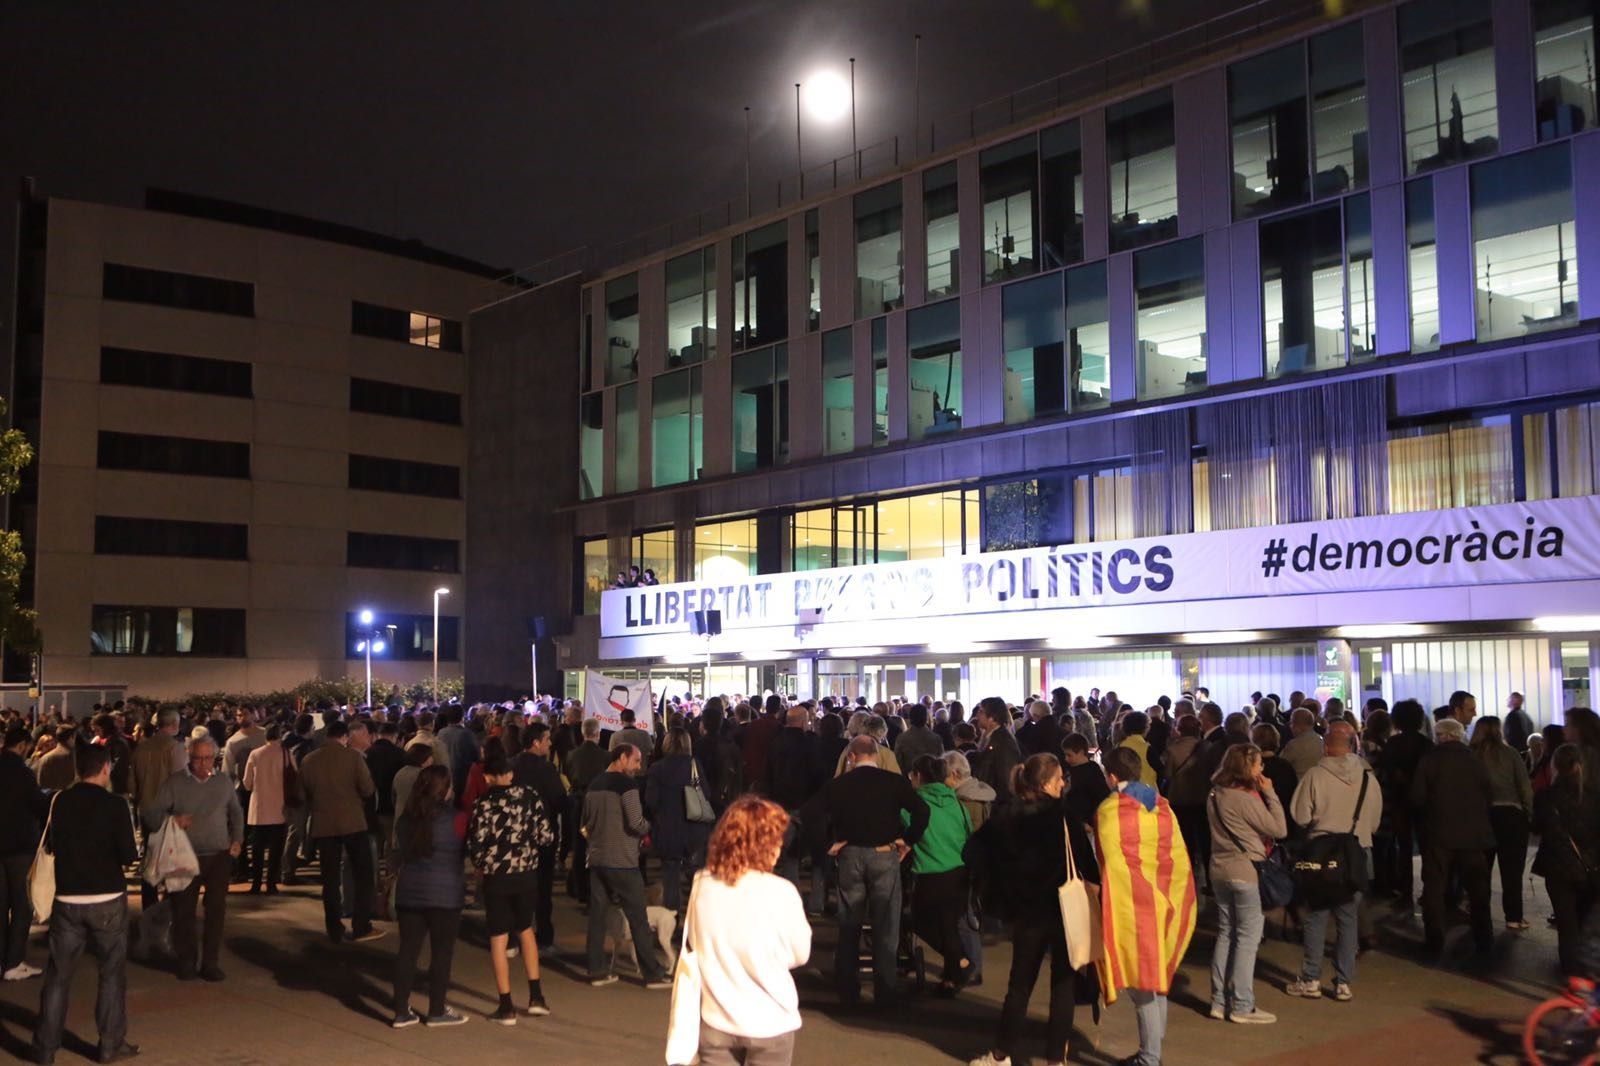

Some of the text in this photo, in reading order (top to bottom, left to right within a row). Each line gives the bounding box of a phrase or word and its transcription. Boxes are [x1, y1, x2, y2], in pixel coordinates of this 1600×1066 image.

[1261, 516, 1565, 578] #democràcia
[625, 582, 772, 628] LLIBERTAT
[961, 545, 1174, 603] POLÍTICS
